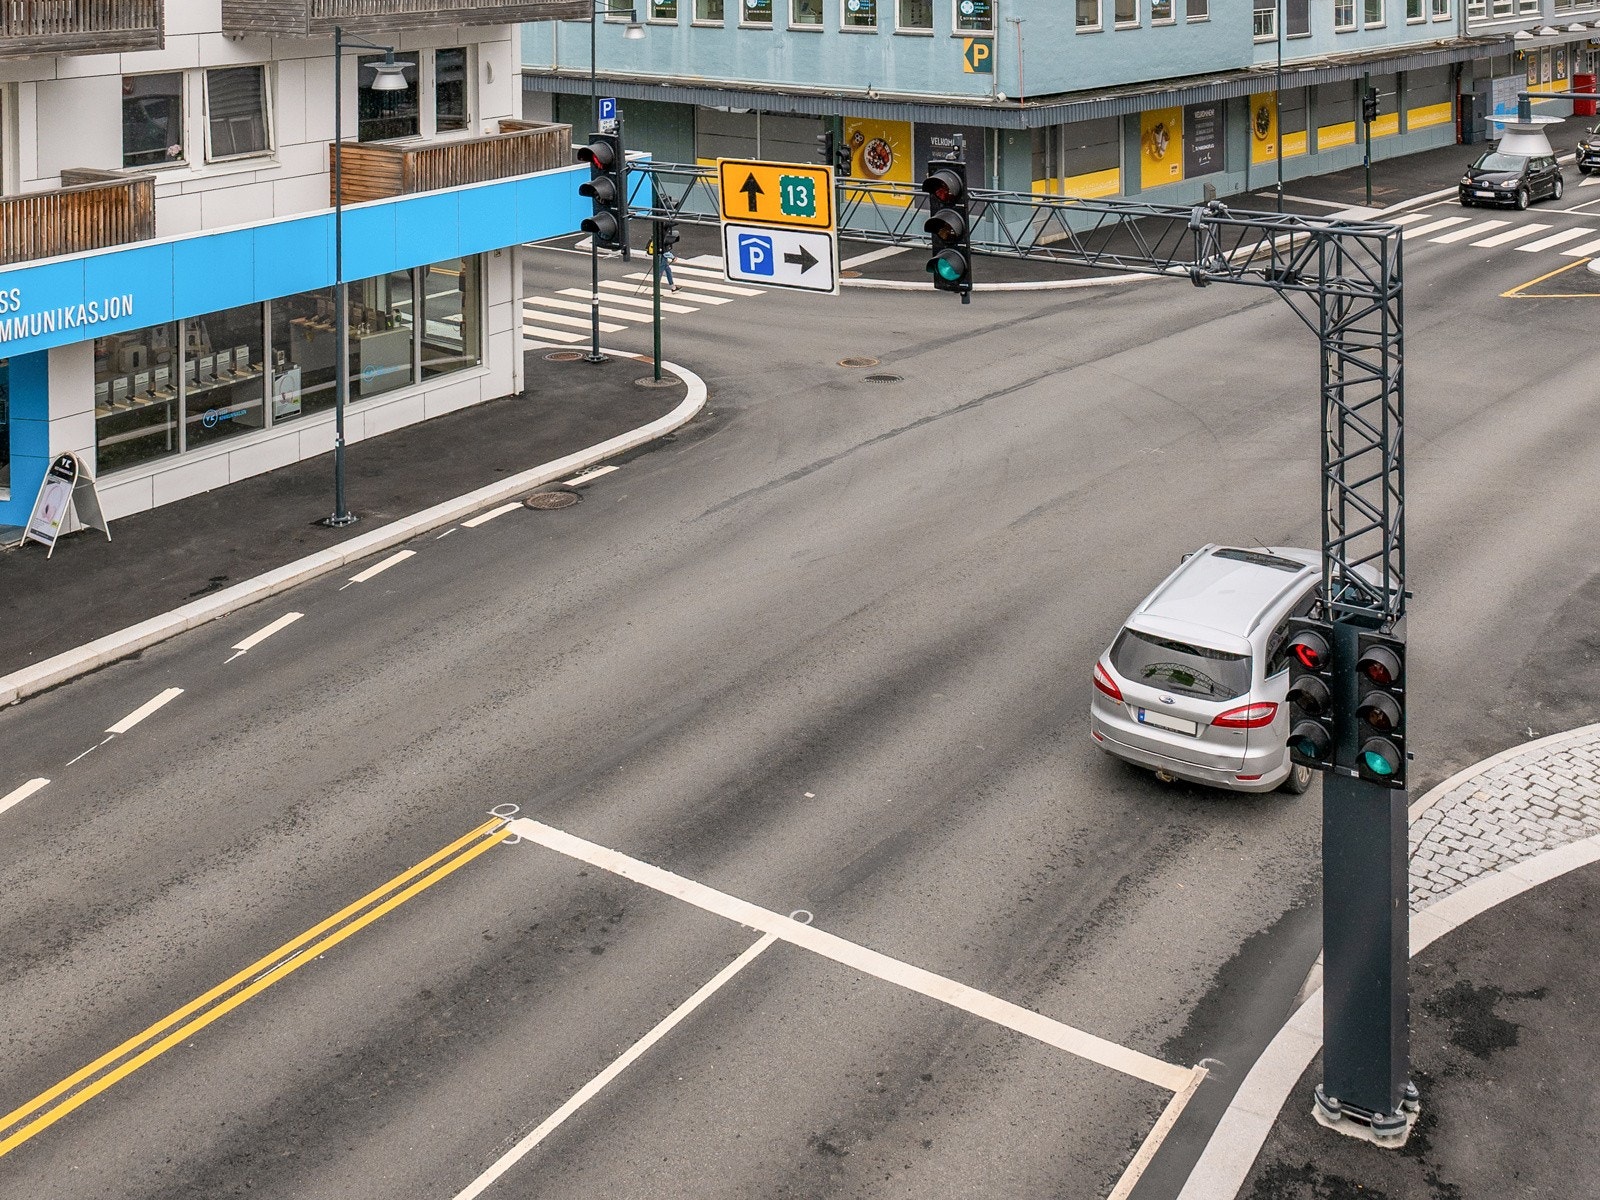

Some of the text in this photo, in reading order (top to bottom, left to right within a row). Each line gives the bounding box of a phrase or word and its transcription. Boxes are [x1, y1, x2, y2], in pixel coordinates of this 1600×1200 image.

[973, 44, 990, 67] P
[603, 101, 612, 117] P
[787, 185, 808, 207] 13
[749, 246, 765, 271] P
